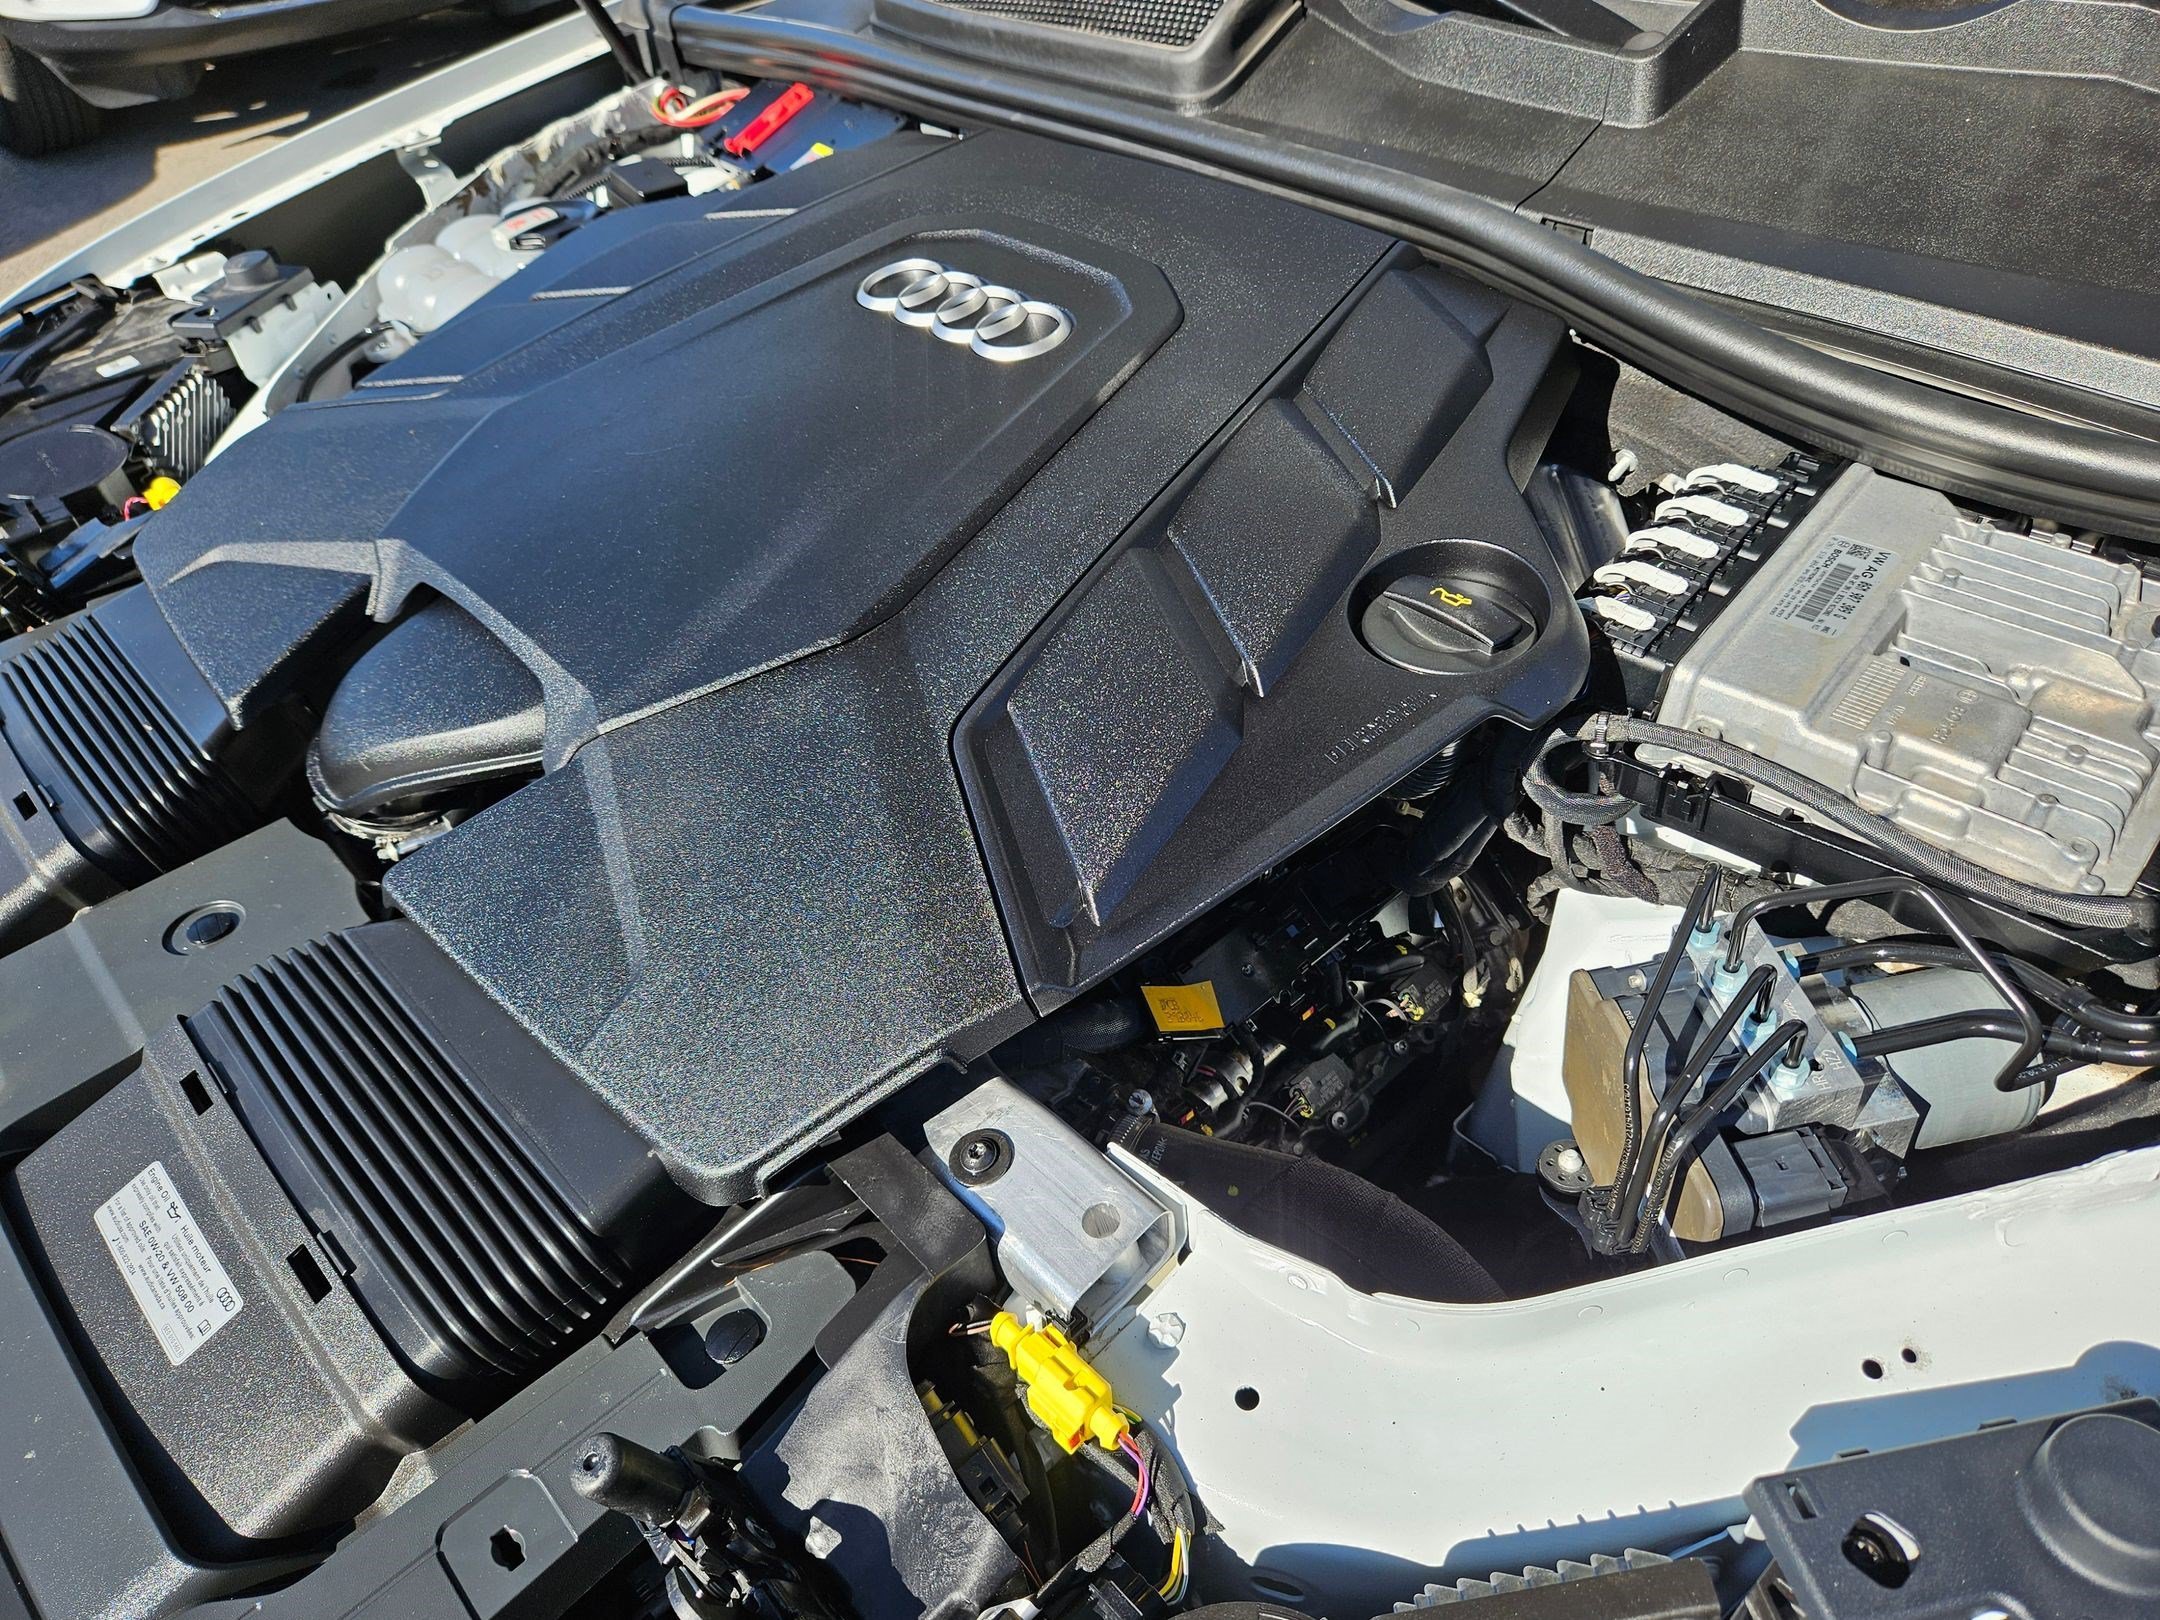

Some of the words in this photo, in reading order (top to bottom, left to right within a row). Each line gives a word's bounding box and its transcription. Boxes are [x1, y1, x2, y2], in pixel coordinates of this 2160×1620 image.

[1822, 549, 1842, 568] BOSCH
[1872, 551, 1891, 566] VW
[1861, 565, 1878, 579] AG
[1929, 705, 1967, 744] BOSCH
[1821, 1048, 1846, 1071] HZ2
[1811, 1073, 1831, 1092] HR
[146, 1167, 165, 1193] Engine
[160, 1189, 171, 1202] Oil
[138, 1219, 152, 1238] SAE
[147, 1235, 166, 1262] 0W-20
[179, 1224, 196, 1246] Huile
[191, 1244, 212, 1274] moteur
[161, 1260, 170, 1271] &
[165, 1267, 179, 1286] VW
[174, 1283, 188, 1302] 508
[183, 1299, 195, 1313] 00
